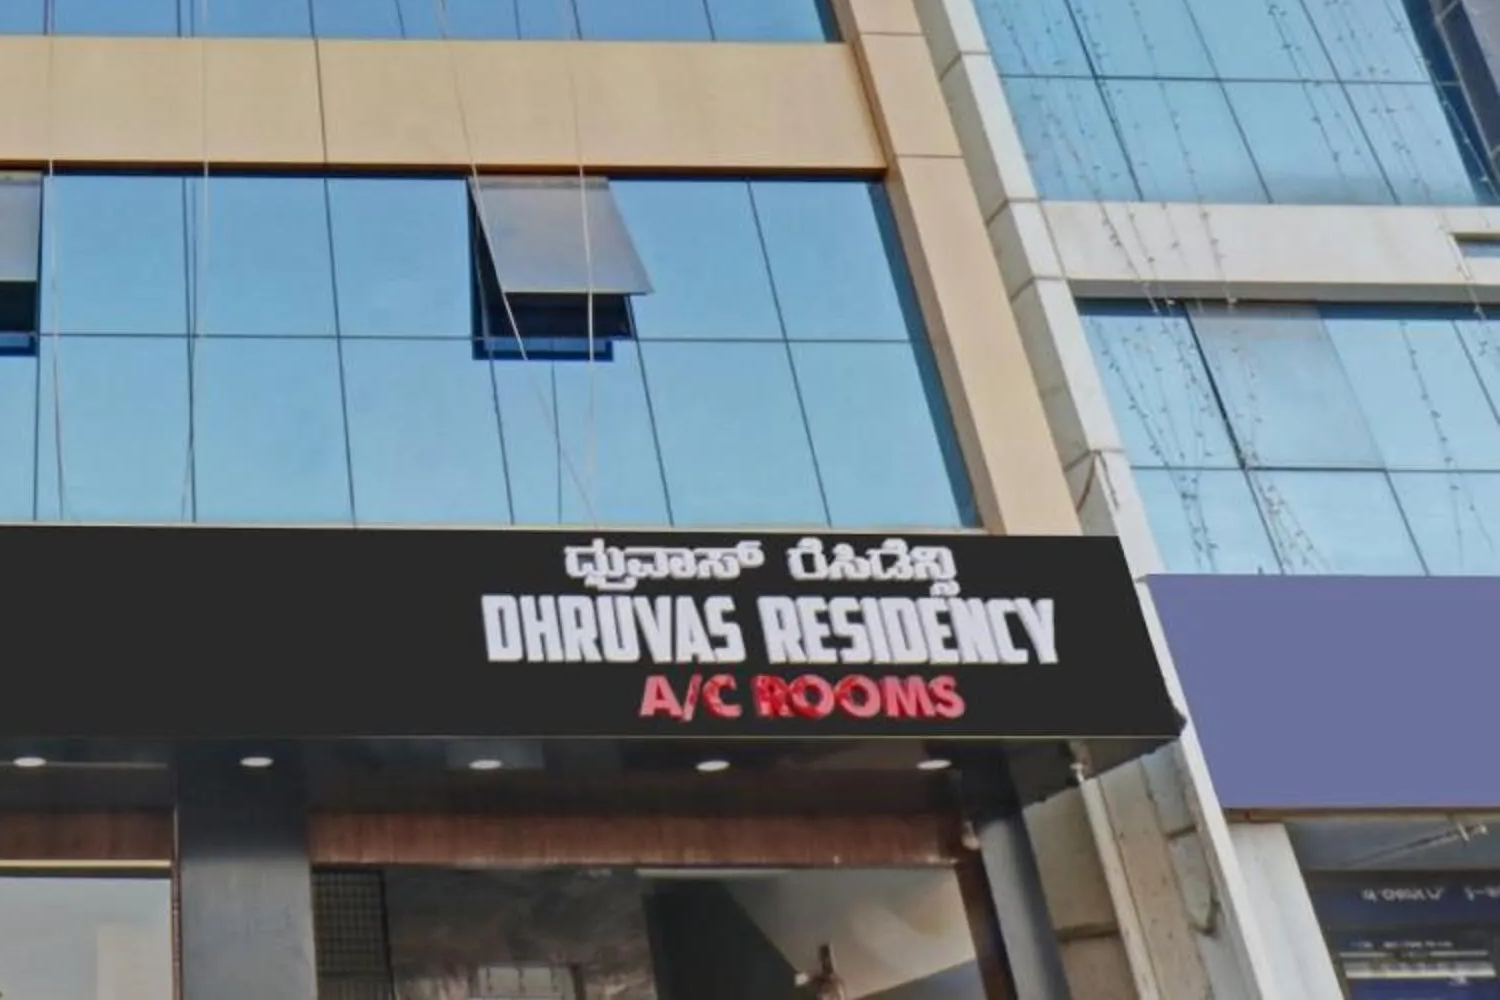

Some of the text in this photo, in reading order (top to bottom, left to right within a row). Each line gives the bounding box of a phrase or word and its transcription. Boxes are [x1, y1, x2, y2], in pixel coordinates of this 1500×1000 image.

[481, 595, 1058, 664] DHRUVAS RESIDENCY
[639, 674, 966, 721] A/C ROOMS
